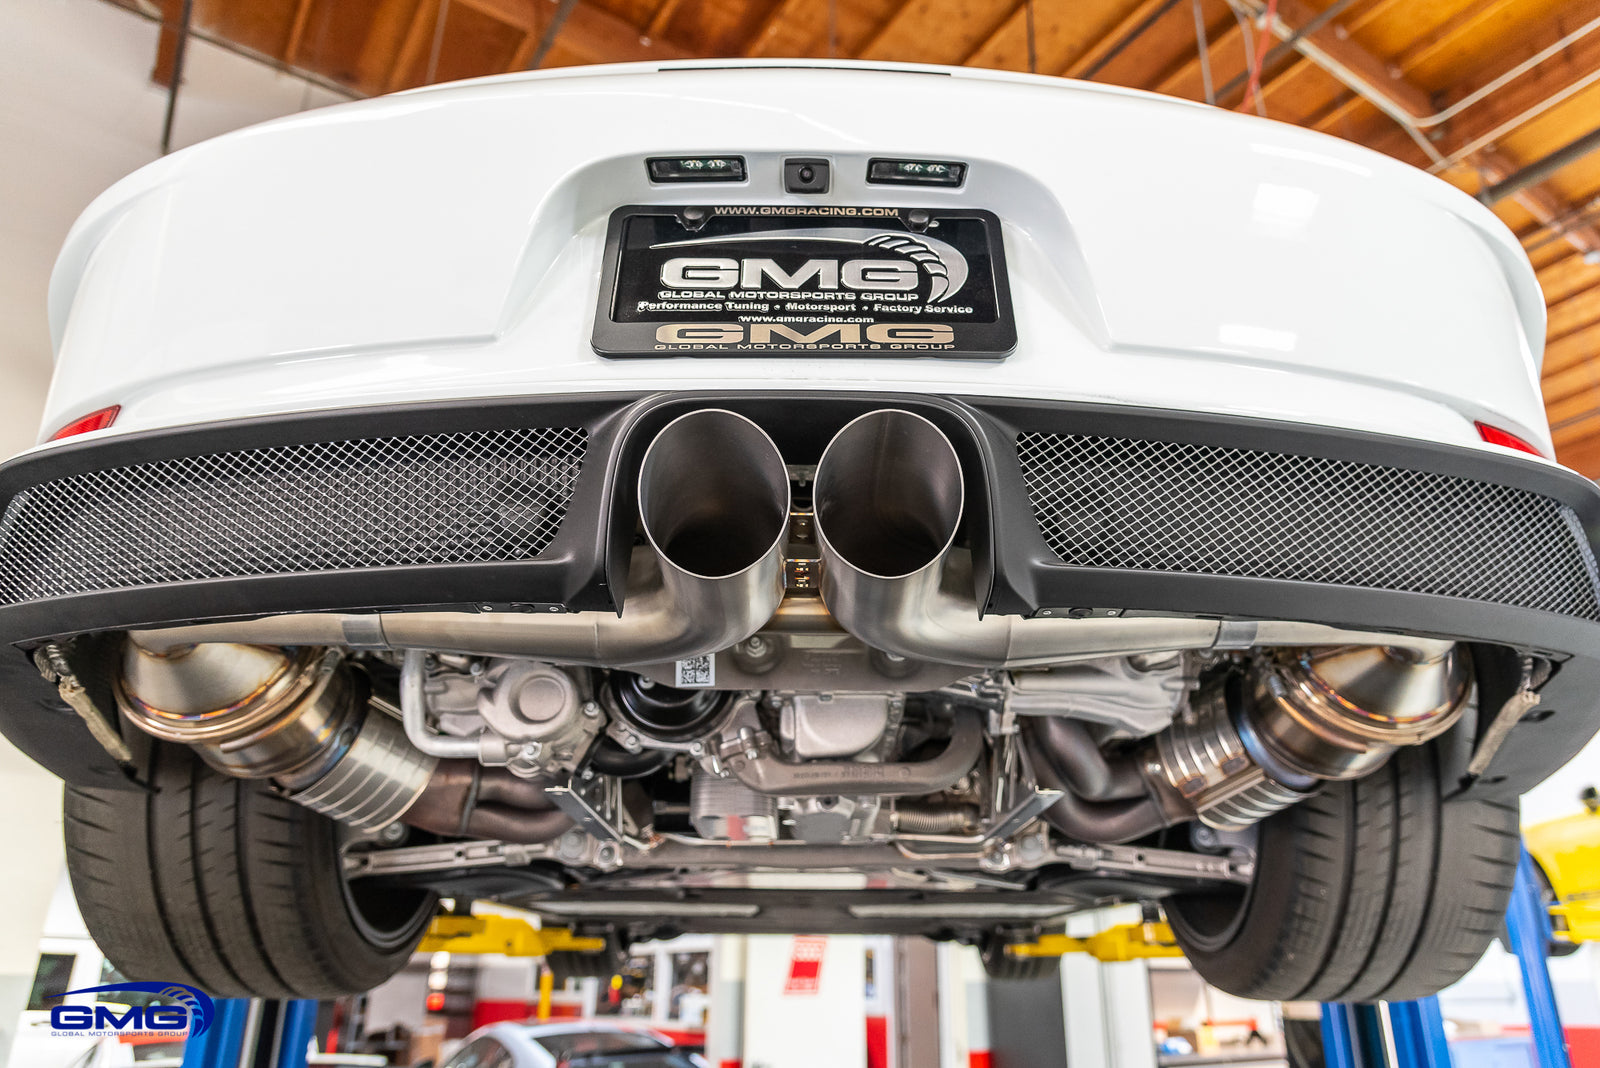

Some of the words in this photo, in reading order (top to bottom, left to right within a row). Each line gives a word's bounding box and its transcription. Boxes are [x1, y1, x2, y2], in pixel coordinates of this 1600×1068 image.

[714, 206, 899, 217] WWW.GMGRACING.COM
[660, 257, 919, 291] GMG
[658, 290, 726, 300] GLOBAL
[729, 291, 857, 301] MOTORSPORTS
[860, 292, 919, 301] GROUP
[637, 301, 723, 312] Performance
[724, 302, 770, 313] Tuning
[785, 303, 857, 313] Motorsport
[873, 303, 922, 314] Factory
[924, 304, 974, 314] Service
[655, 323, 955, 344] GMG
